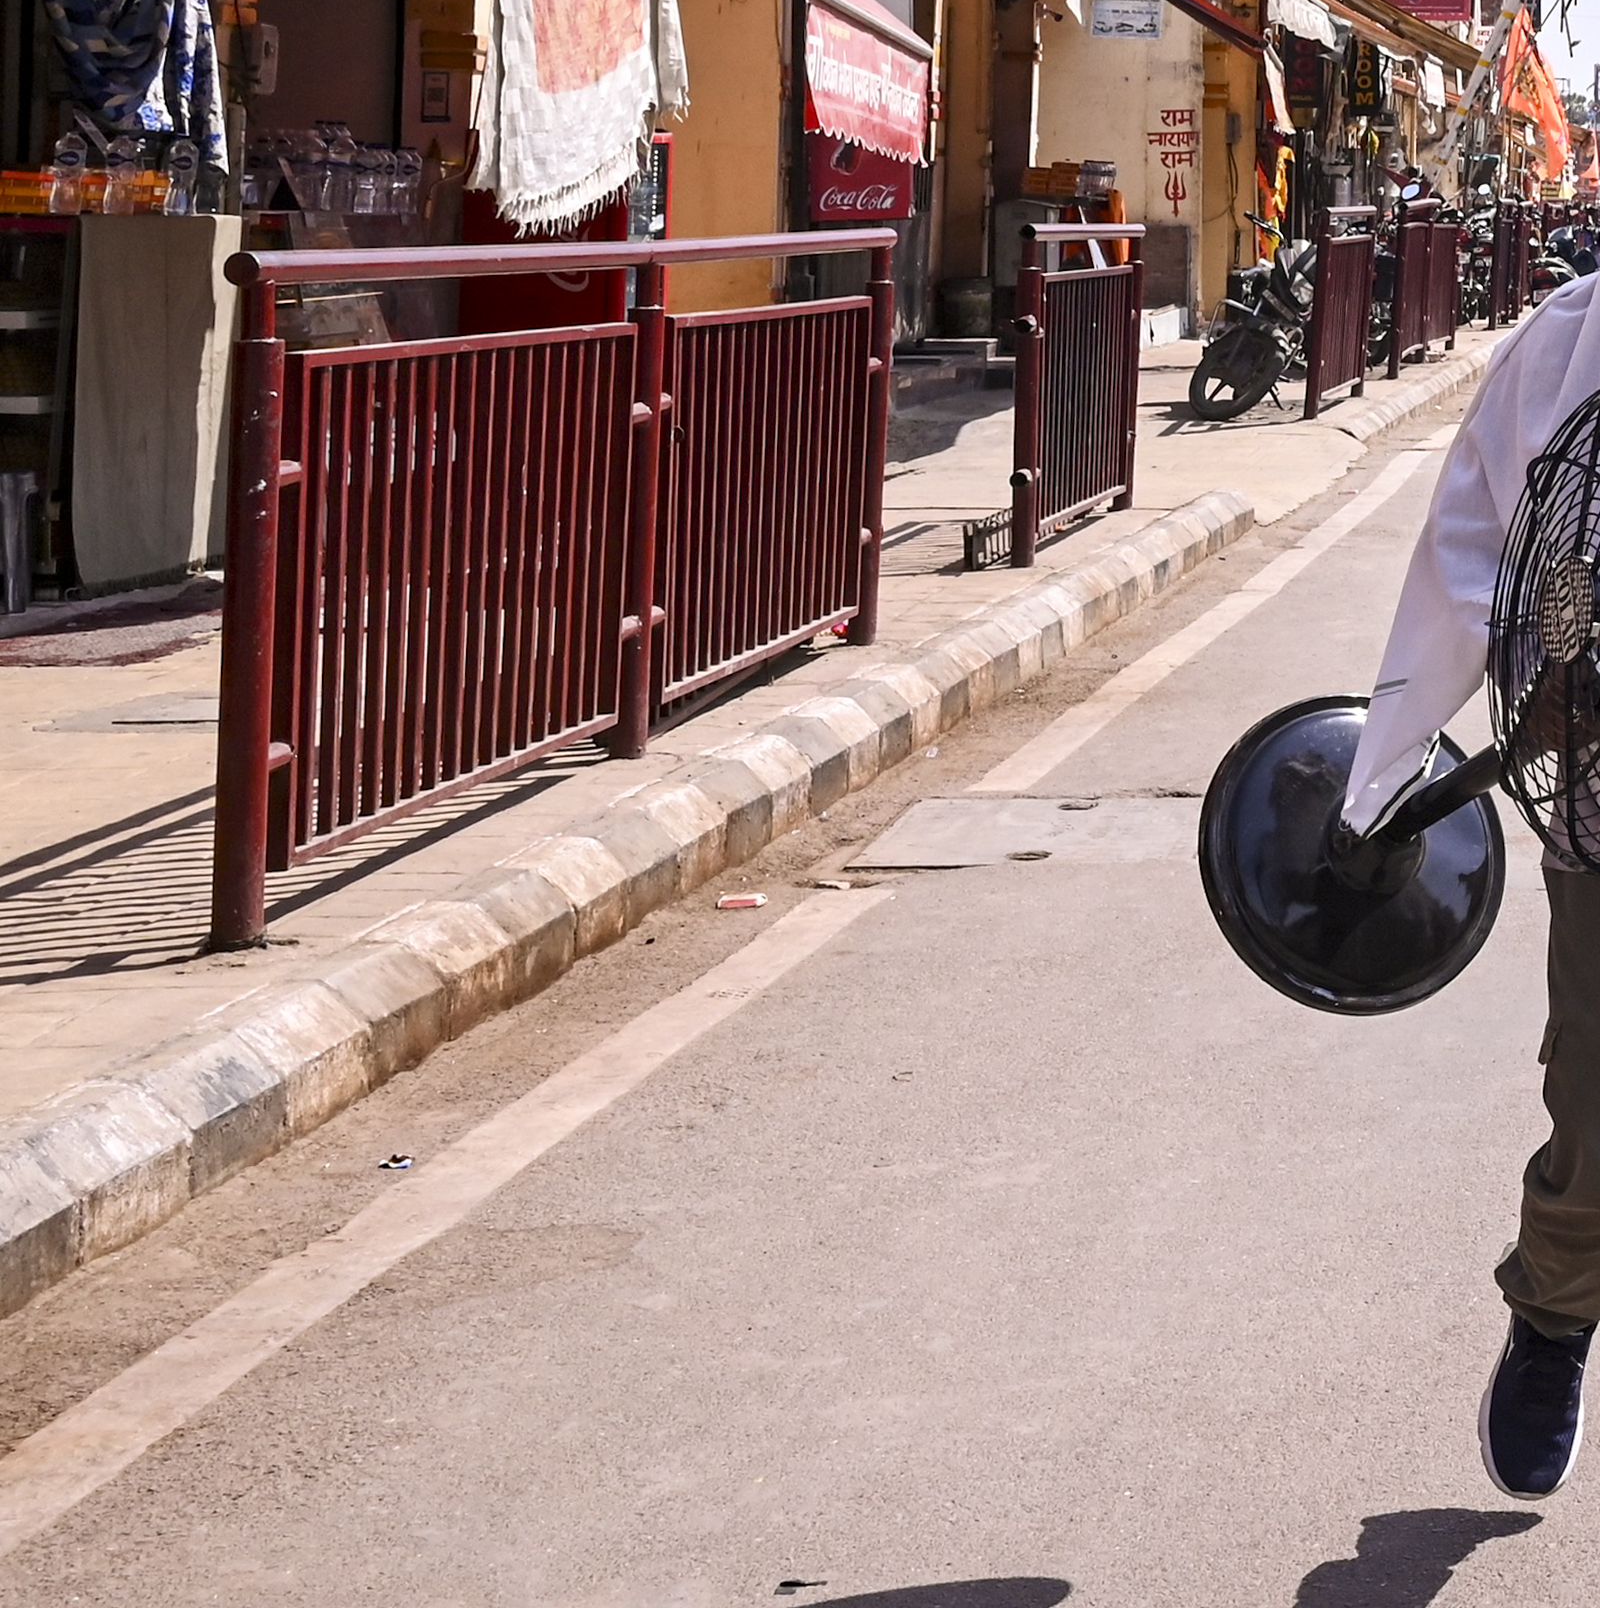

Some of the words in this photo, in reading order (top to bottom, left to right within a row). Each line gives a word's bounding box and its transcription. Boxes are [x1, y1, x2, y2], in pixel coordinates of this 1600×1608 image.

[1355, 40, 1375, 106] ROOM
[1160, 109, 1195, 128] राम
[1147, 131, 1200, 148] नारायण
[1160, 150, 1196, 169] राम
[1556, 562, 1578, 660] POLAR
